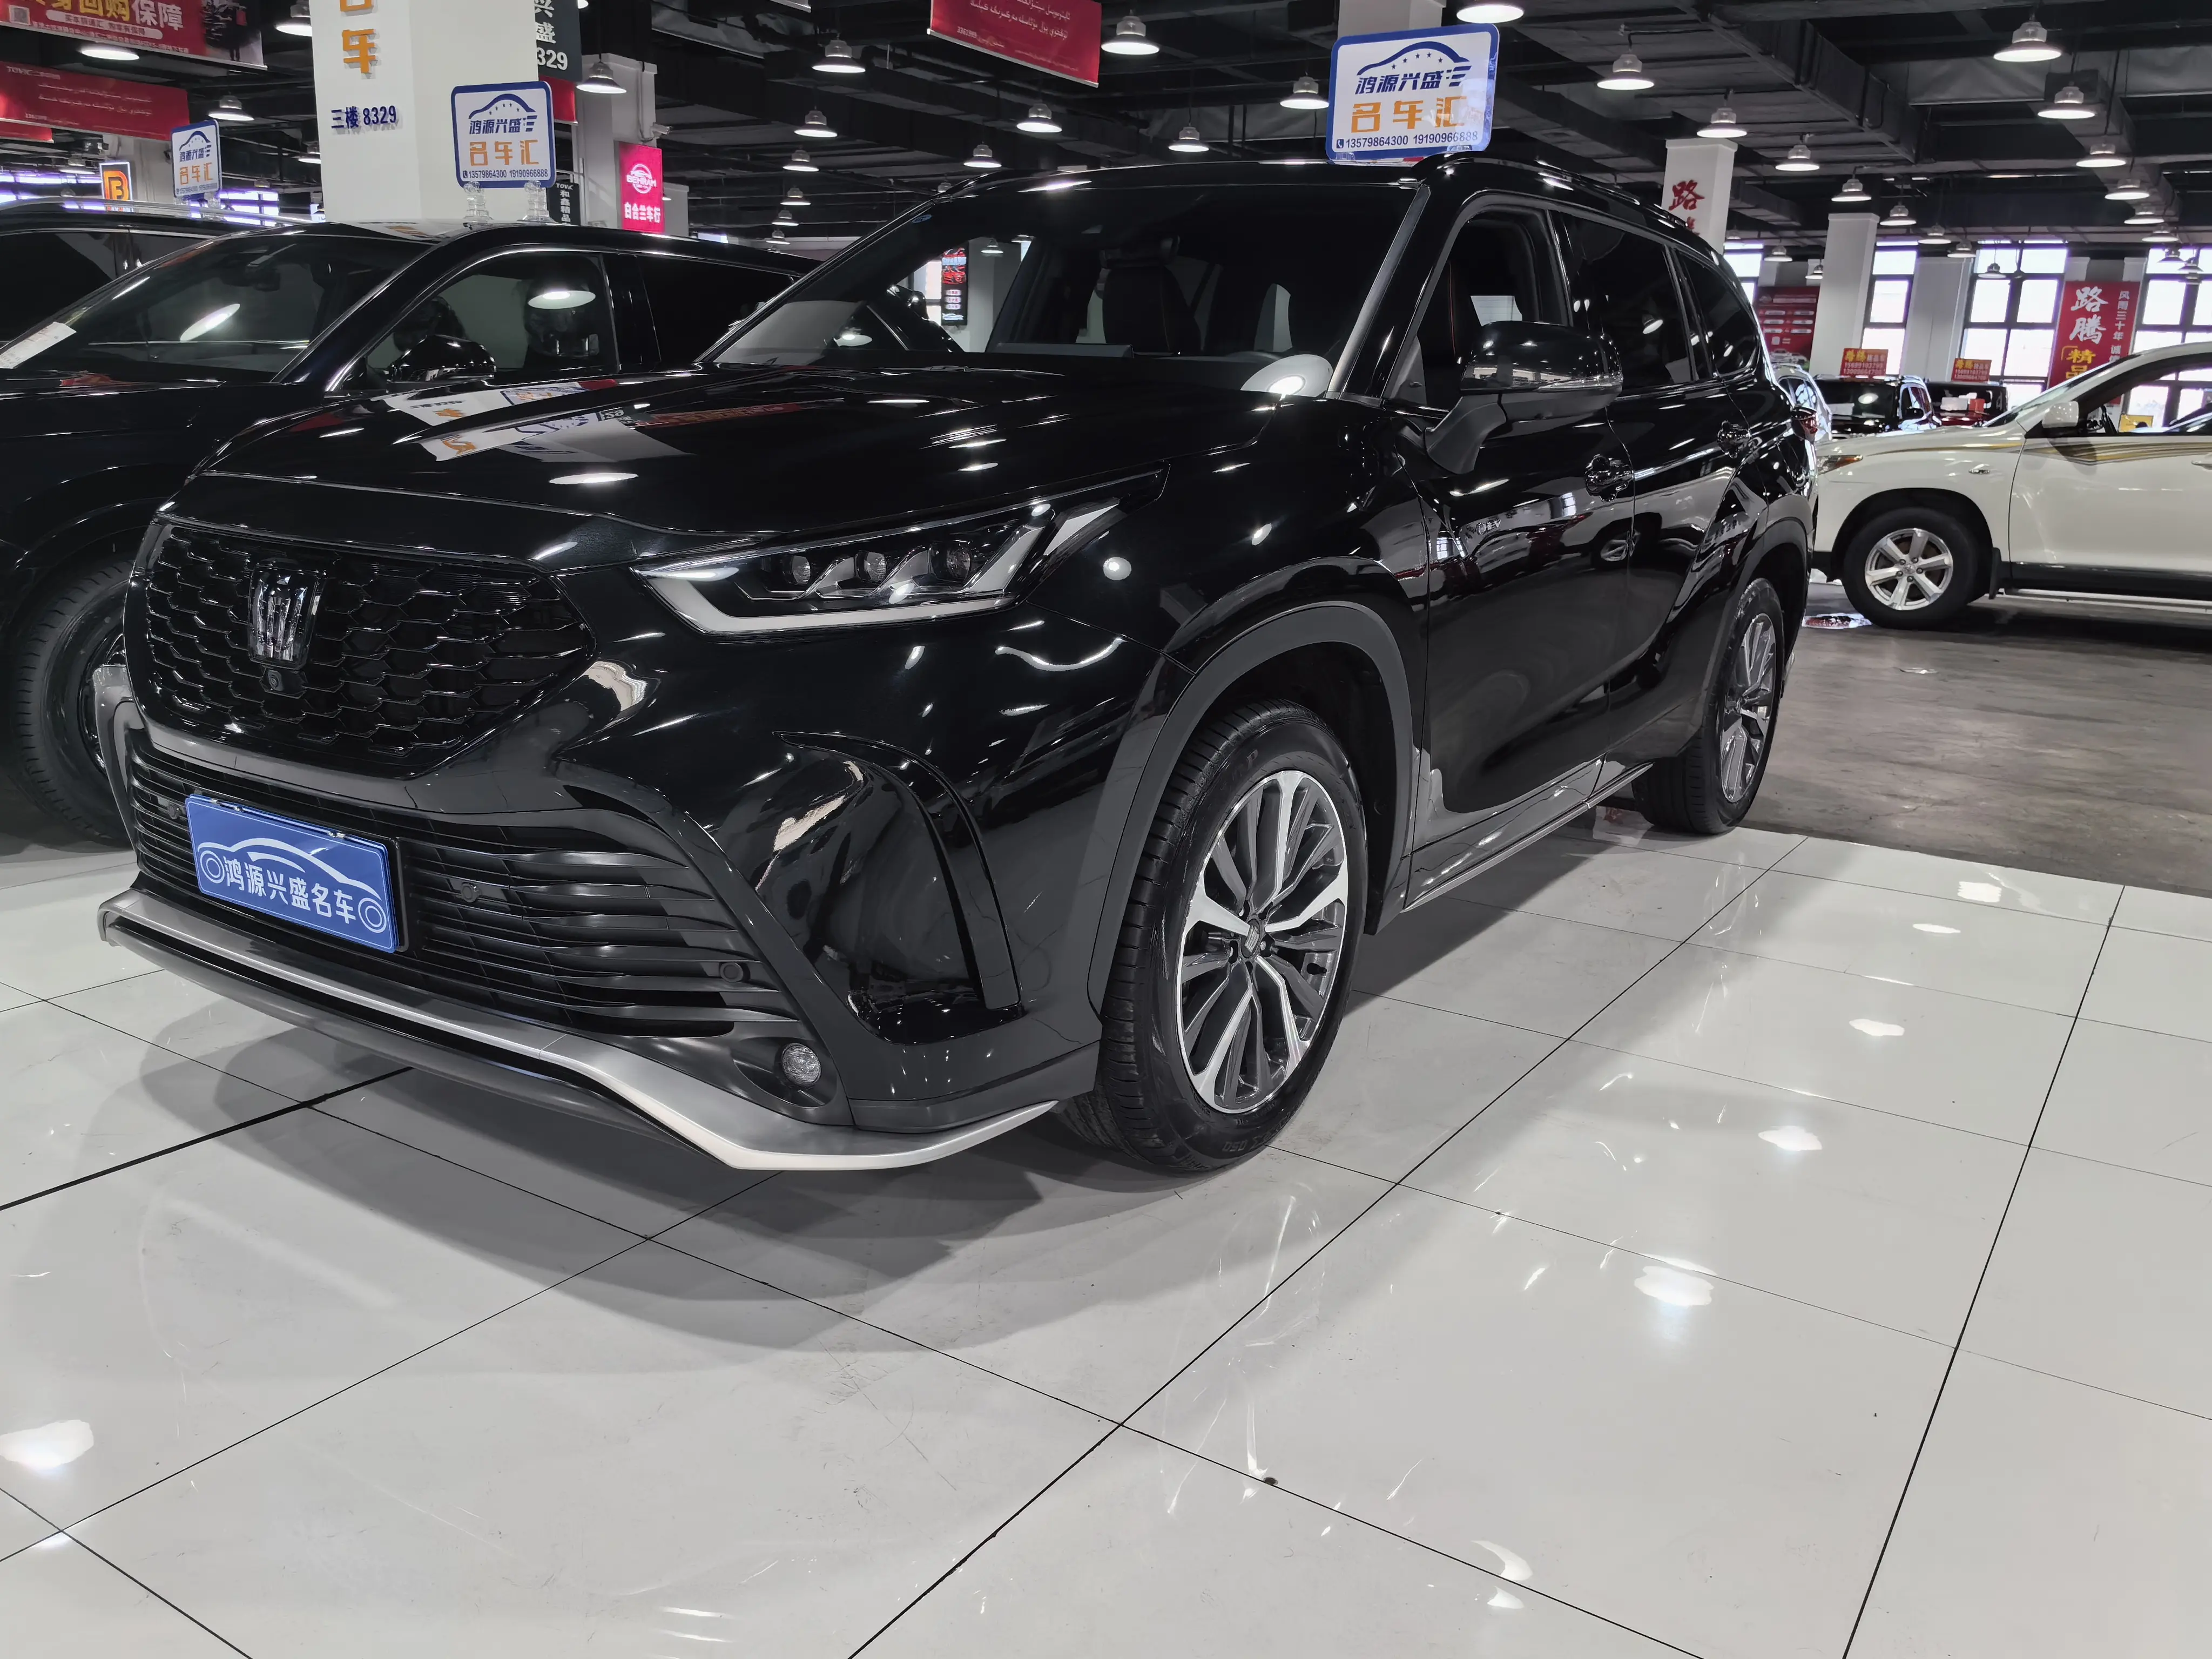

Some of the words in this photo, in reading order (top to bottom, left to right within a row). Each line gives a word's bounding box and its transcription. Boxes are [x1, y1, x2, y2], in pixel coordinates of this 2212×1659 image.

[1355, 71, 1443, 95] 鸿源兴盛
[331, 106, 359, 129] 三楼
[362, 105, 397, 125] 8329
[469, 118, 522, 135] 鸿源兴盛
[1351, 96, 1467, 133] 名车汇
[1346, 135, 1408, 149] 13579864300
[1413, 131, 1479, 145] 19190966888
[469, 139, 539, 166] 名车汇
[180, 162, 213, 185] 名车汇
[468, 170, 507, 179] 13579864300
[509, 168, 549, 178] 19190966888
[222, 855, 356, 925] 鸿源兴盛名车
